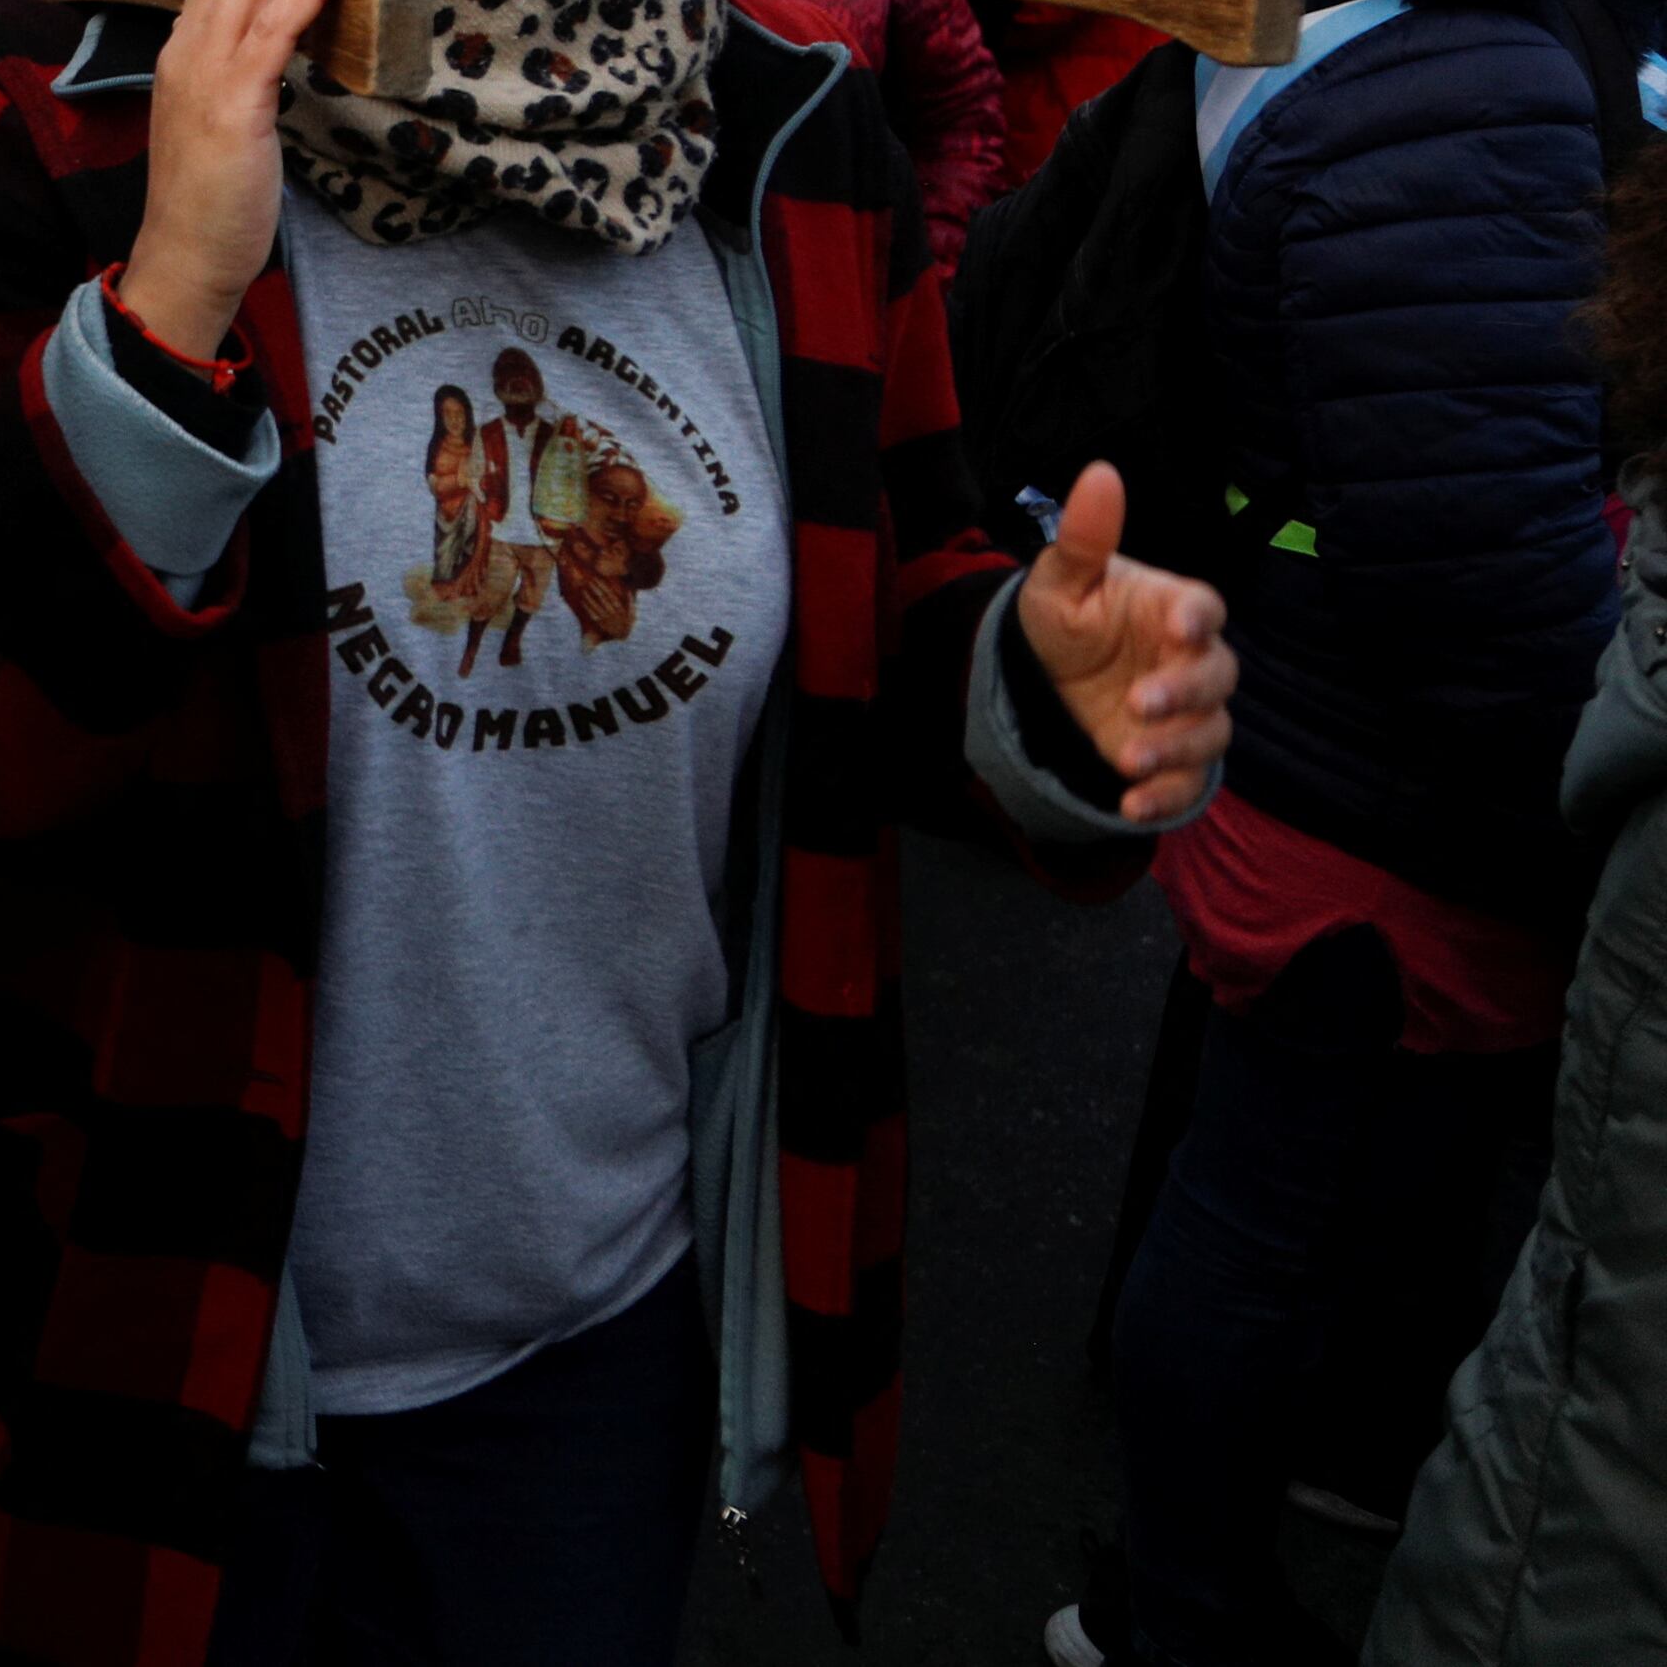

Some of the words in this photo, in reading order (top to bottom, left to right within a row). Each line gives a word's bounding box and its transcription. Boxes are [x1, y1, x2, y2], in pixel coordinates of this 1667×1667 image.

[310, 306, 446, 445] PASTORAL
[556, 325, 742, 516] ARGENTINA
[326, 581, 464, 751] NEGRO
[472, 625, 736, 752] MANUEL
